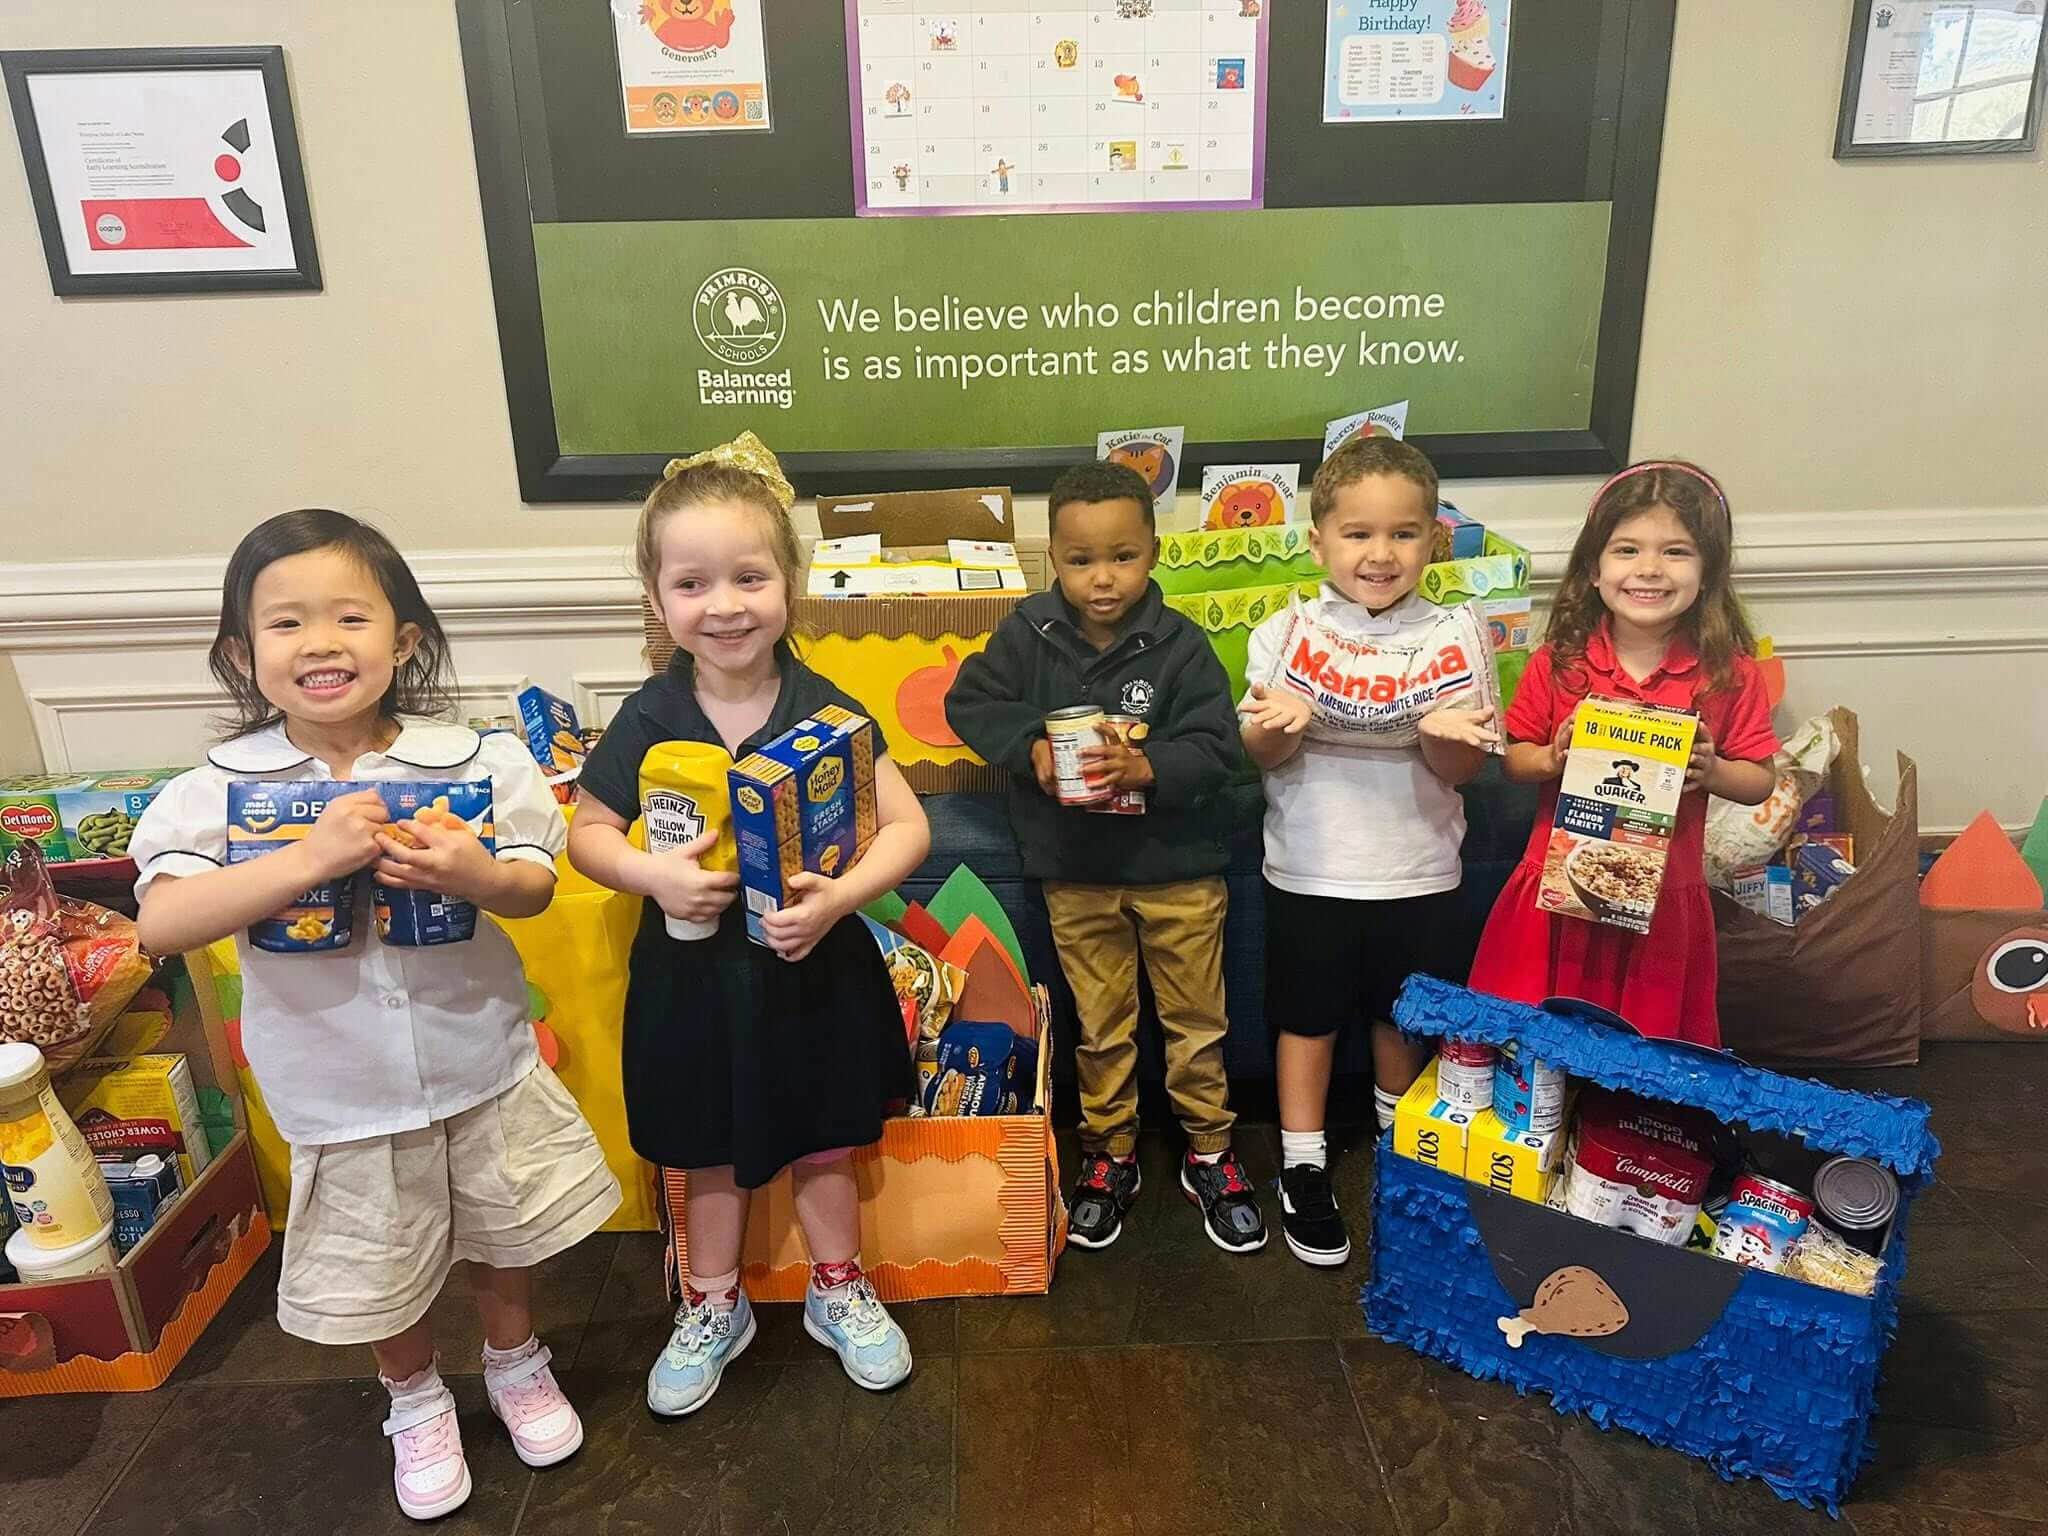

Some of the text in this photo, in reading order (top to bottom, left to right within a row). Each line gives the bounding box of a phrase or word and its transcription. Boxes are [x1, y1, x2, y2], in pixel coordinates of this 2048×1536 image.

[1369, 0, 1418, 12] Happy
[1359, 15, 1432, 34] Birthday!
[660, 46, 718, 63] Generosity
[699, 273, 777, 306] PRIMROSE
[817, 285, 1445, 333] We believe who children become
[718, 343, 768, 362] SCHOOLS
[823, 331, 1465, 390] is as important as what they know.
[697, 369, 792, 389] Balanced
[699, 387, 796, 409] Learning
[1105, 431, 1141, 450] Katie
[1153, 432, 1173, 447] Cat
[1326, 423, 1357, 452] Percy
[1367, 411, 1402, 433] Rooster
[1202, 466, 1262, 503] Benjamin
[1272, 475, 1295, 501] Bear
[1317, 692, 1367, 719] AMERICA'S
[1412, 688, 1435, 706] RICE
[1585, 721, 1683, 751] 18 VALUE PACK
[810, 763, 841, 793] Honey
[813, 777, 838, 799] Maid
[1594, 784, 1645, 805] QUAKER
[131, 796, 143, 809] 8
[291, 800, 330, 818] DE
[653, 798, 686, 815] HEINZ
[813, 799, 842, 823] FRESH
[2, 813, 53, 826] Del Monte
[653, 818, 686, 832] YELLOW
[811, 807, 845, 835] STACKS
[1563, 816, 1604, 832] VARIETY
[1567, 808, 1604, 824] FLAVOR
[649, 829, 694, 844] MUSTARD
[298, 889, 329, 903] UXE
[1735, 880, 1765, 895] JIFFY
[970, 1073, 986, 1116] ARMOU
[87, 1129, 126, 1141] CHOLES
[127, 1126, 166, 1136] LOWER
[1615, 1156, 1695, 1194] Campbell's
[1599, 1181, 1606, 1189] 4
[1622, 1199, 1659, 1217] Mushroom
[1627, 1194, 1658, 1211] Cream of
[117, 1210, 140, 1220] ESSO
